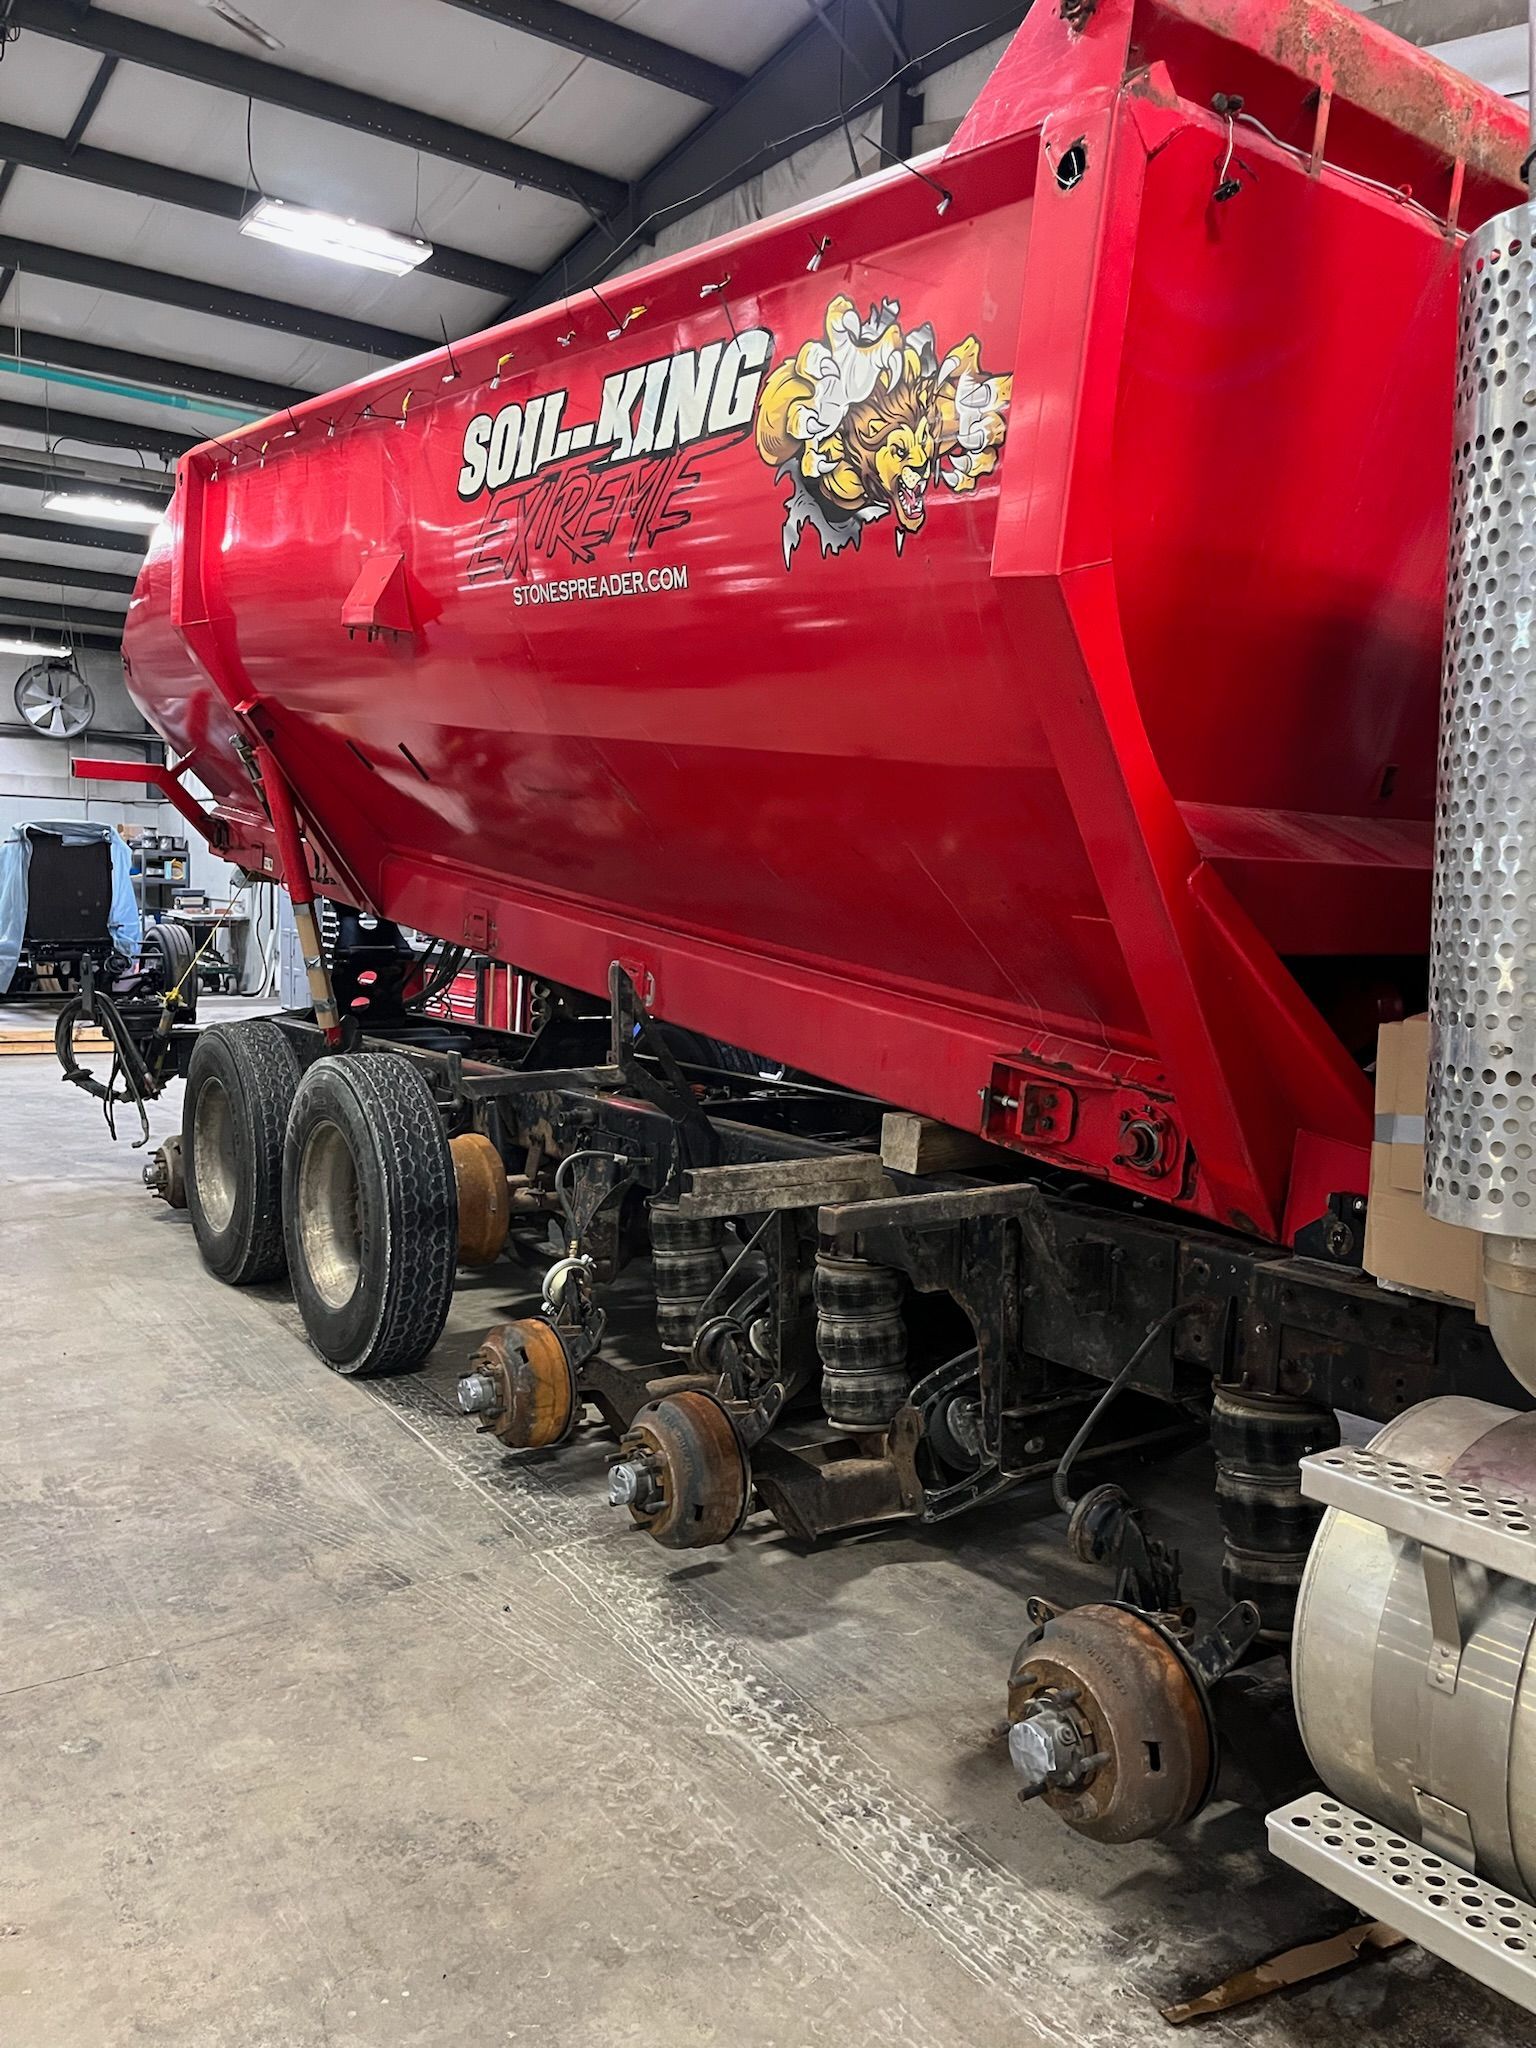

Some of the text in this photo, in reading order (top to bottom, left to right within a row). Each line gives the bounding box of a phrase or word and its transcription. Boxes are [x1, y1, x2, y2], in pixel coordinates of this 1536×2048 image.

[458, 328, 773, 501] SOIL-KING
[467, 432, 745, 583] EXTREME
[512, 565, 688, 605] STONESPREADER.COM
